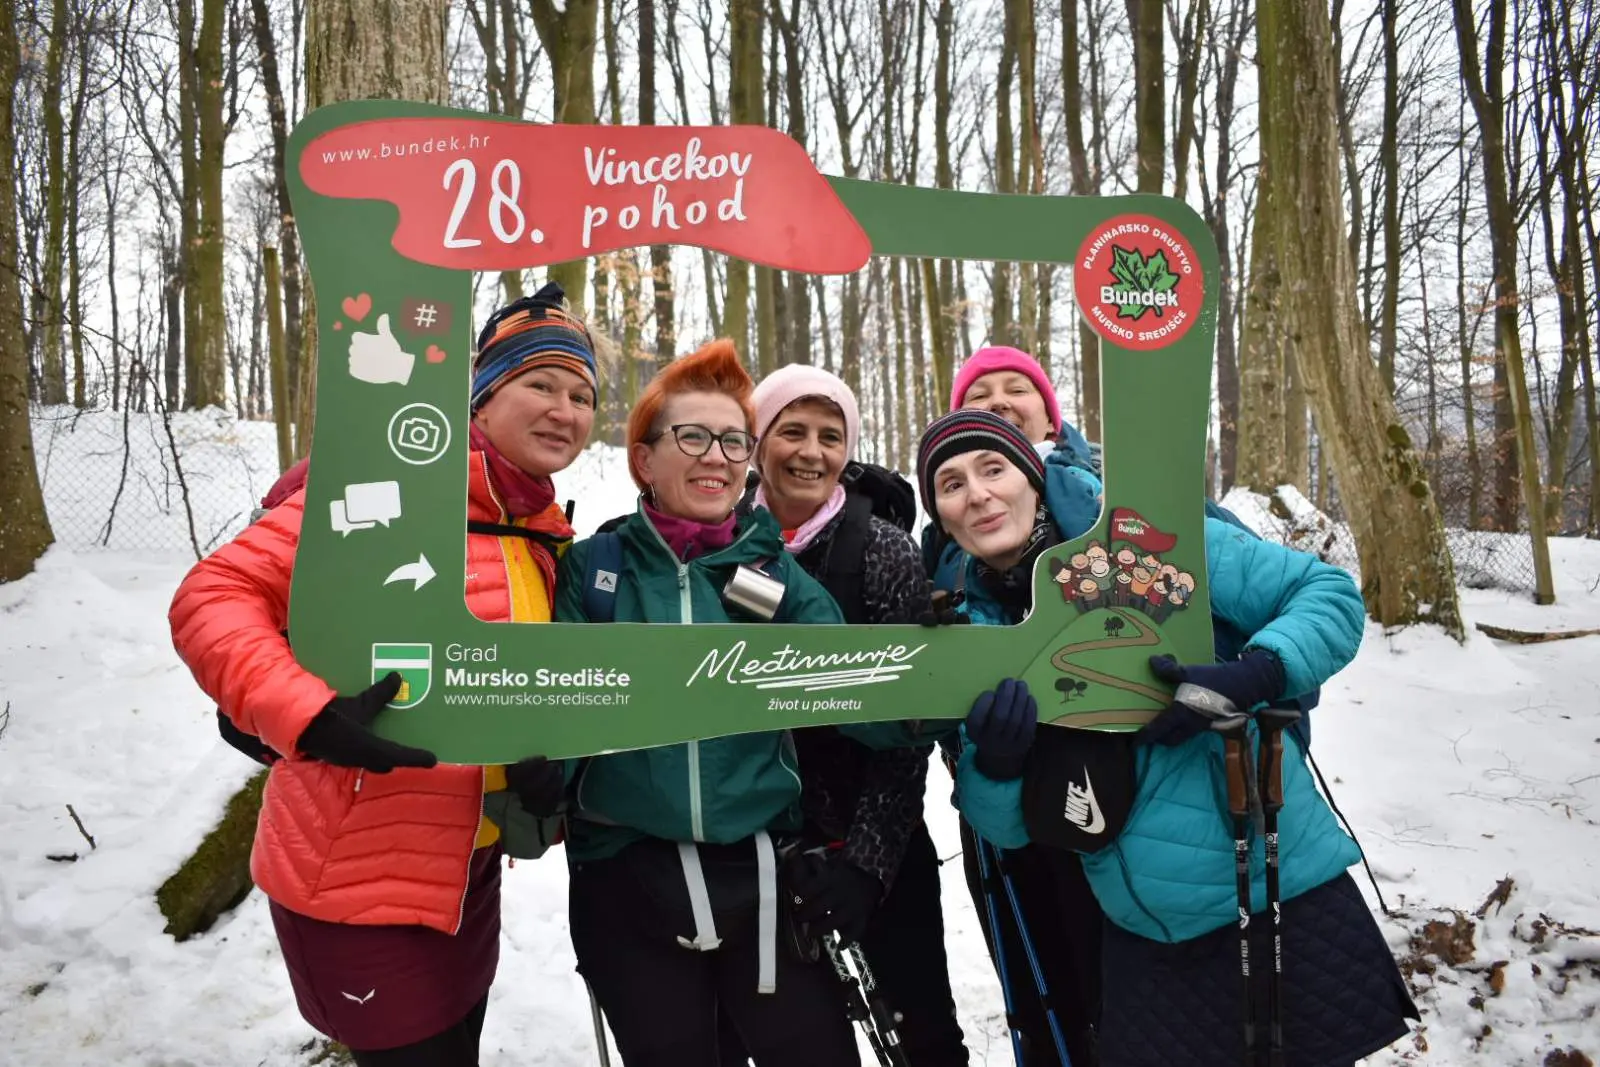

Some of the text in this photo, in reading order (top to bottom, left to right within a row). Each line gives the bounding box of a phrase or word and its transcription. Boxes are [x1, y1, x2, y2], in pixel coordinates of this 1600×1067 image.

[322, 134, 490, 164] www.bundek.hr
[584, 137, 752, 186] Vincekov
[443, 158, 545, 249] 28.
[582, 177, 747, 249] pohod
[1083, 223, 1150, 270] PLANINARSKO
[1100, 286, 1178, 307] Bundek
[1091, 305, 1134, 340] MURSKO
[1117, 522, 1145, 535] Bundek
[445, 643, 498, 662] Grad
[445, 668, 631, 687] Mursko Središće
[444, 692, 631, 706] www.mursko-sredisce.hr
[767, 698, 862, 713] život u pokretu
[1063, 780, 1090, 828] NIKE
